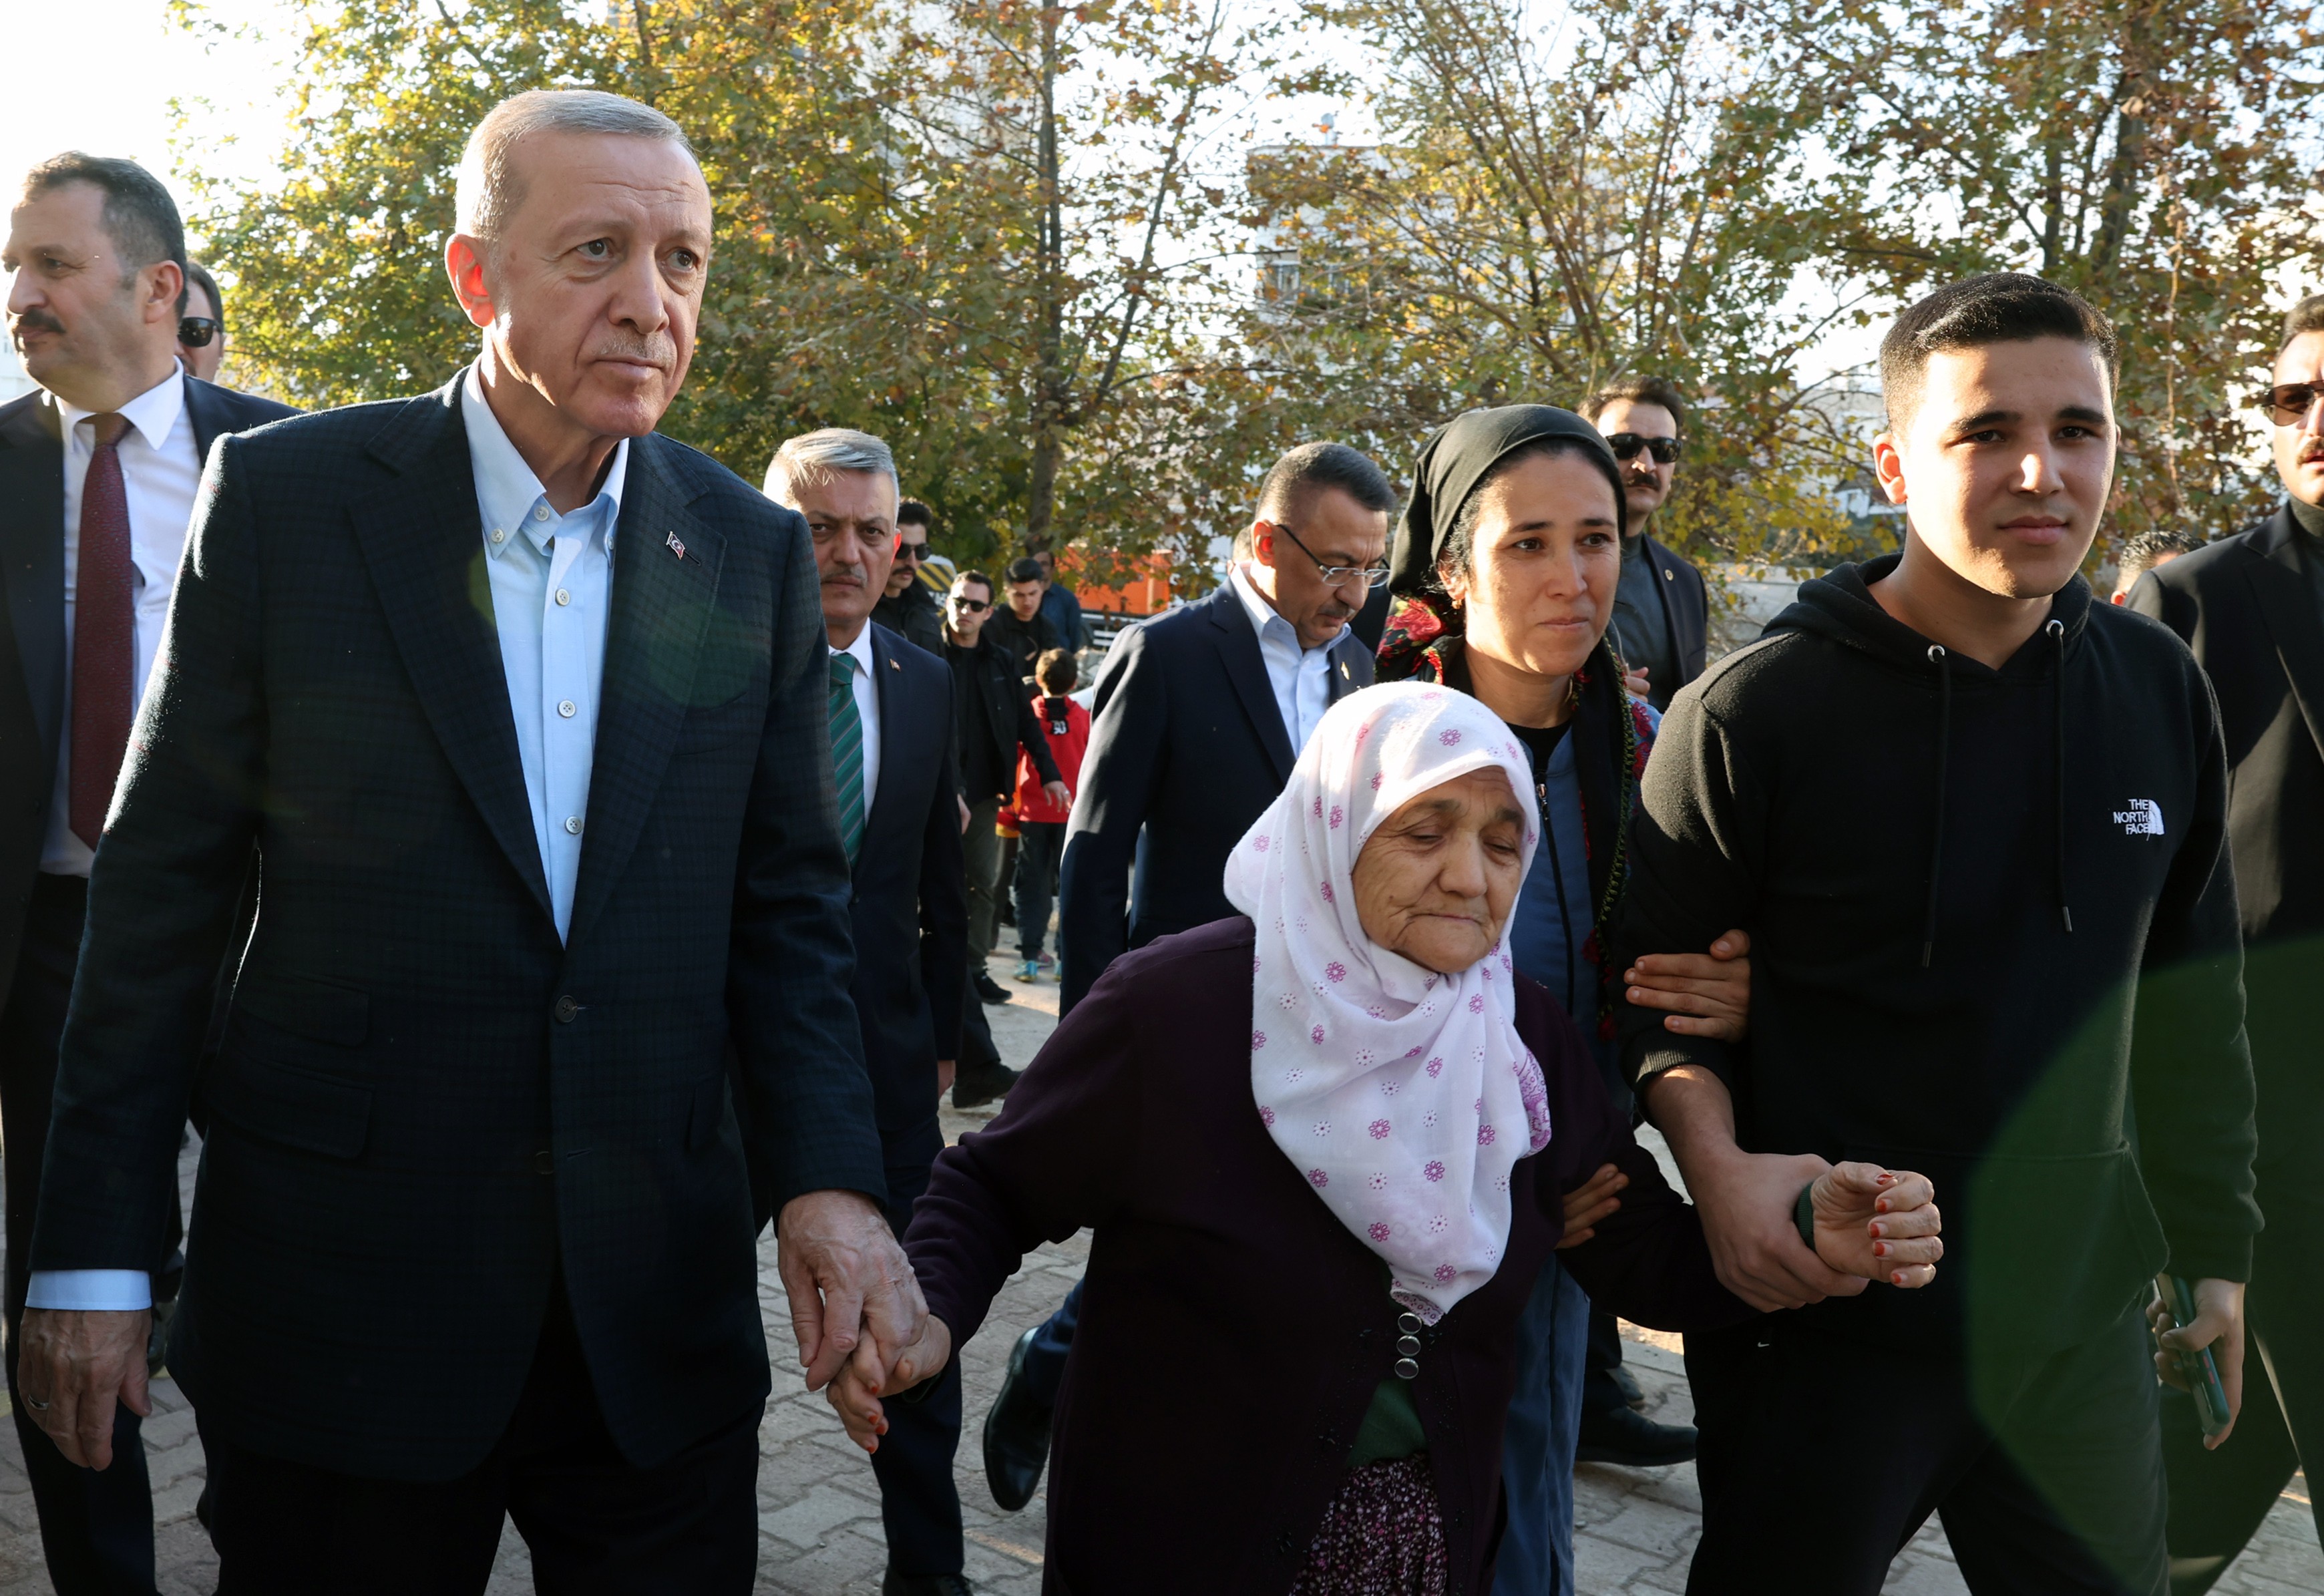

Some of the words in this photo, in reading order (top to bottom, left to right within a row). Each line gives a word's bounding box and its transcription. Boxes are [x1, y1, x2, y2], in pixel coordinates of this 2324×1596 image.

[2128, 799, 2148, 810] THE
[2113, 811, 2148, 823] NORTH
[2126, 823, 2148, 835] FACE
